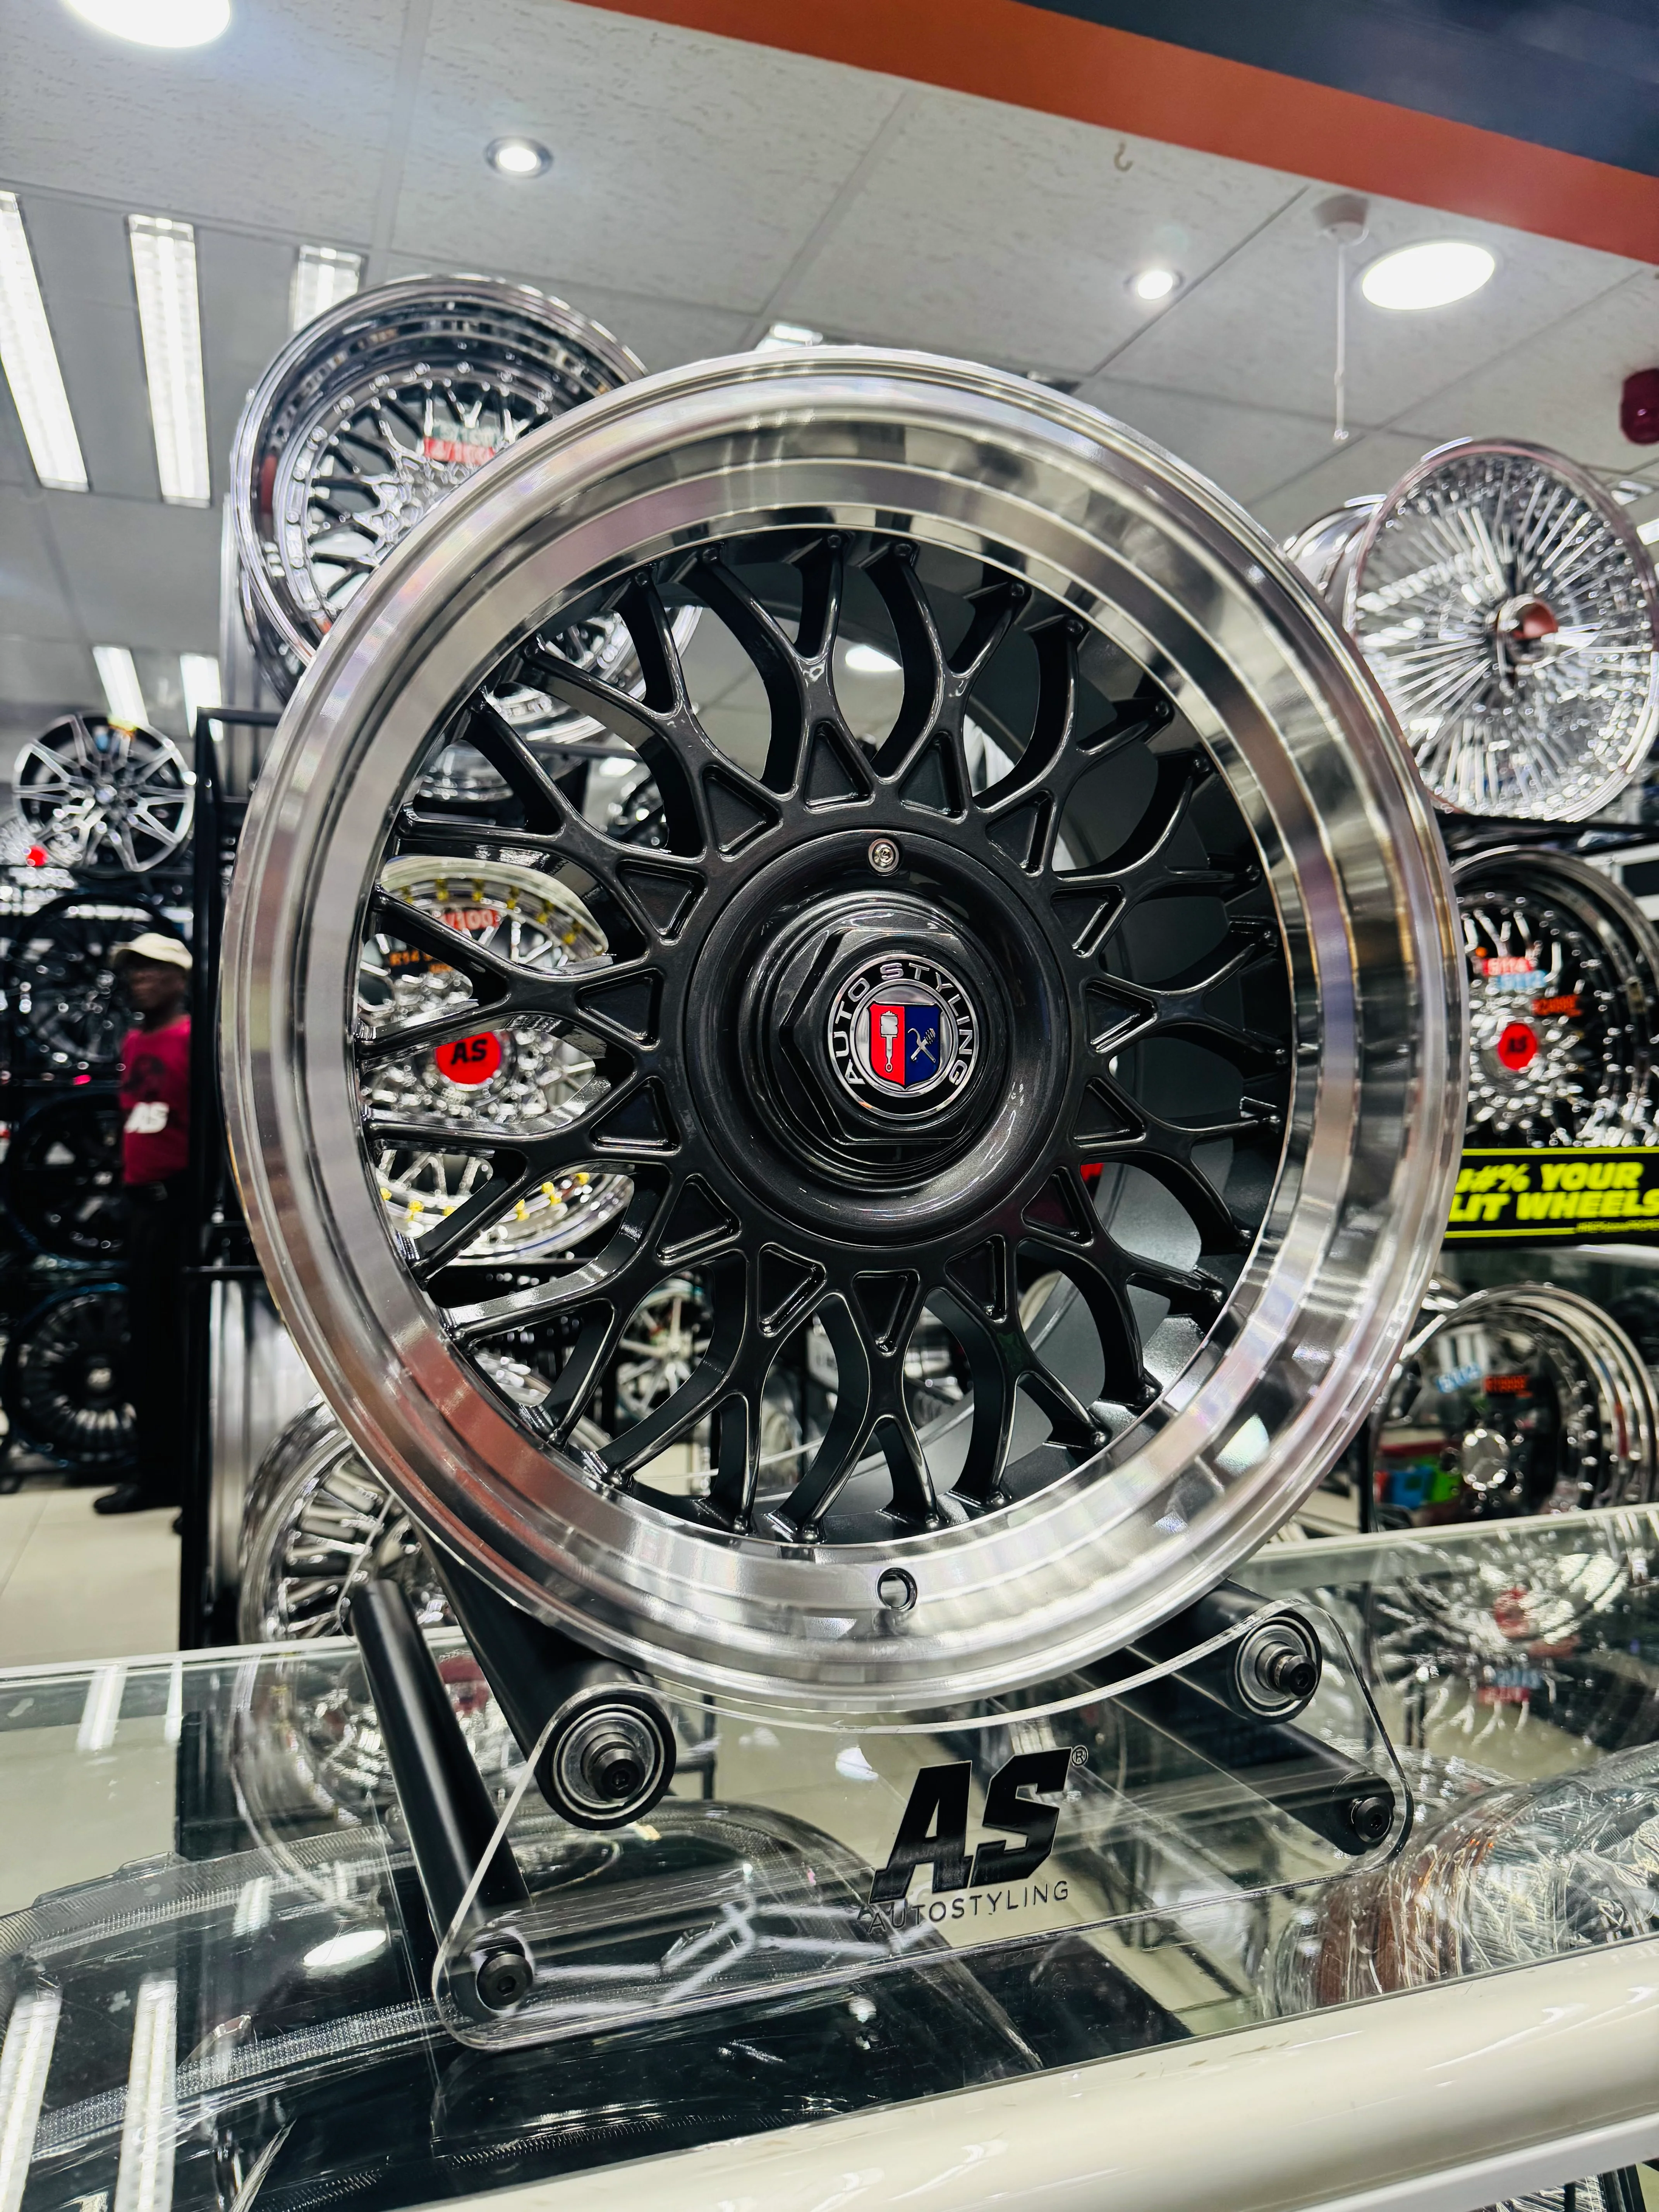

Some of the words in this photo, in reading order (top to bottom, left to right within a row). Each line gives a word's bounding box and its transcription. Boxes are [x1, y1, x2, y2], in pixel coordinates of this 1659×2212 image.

[833, 977, 871, 1085] AUTO
[879, 962, 974, 1085] STYLING
[450, 1039, 487, 1065] AS
[123, 1101, 170, 1133] AS
[1540, 1162, 1644, 1191] YOUR
[1516, 1188, 1659, 1220] WHEELS
[869, 1747, 1072, 1904] AS
[868, 1881, 1068, 1933] AUTOSTYLING
